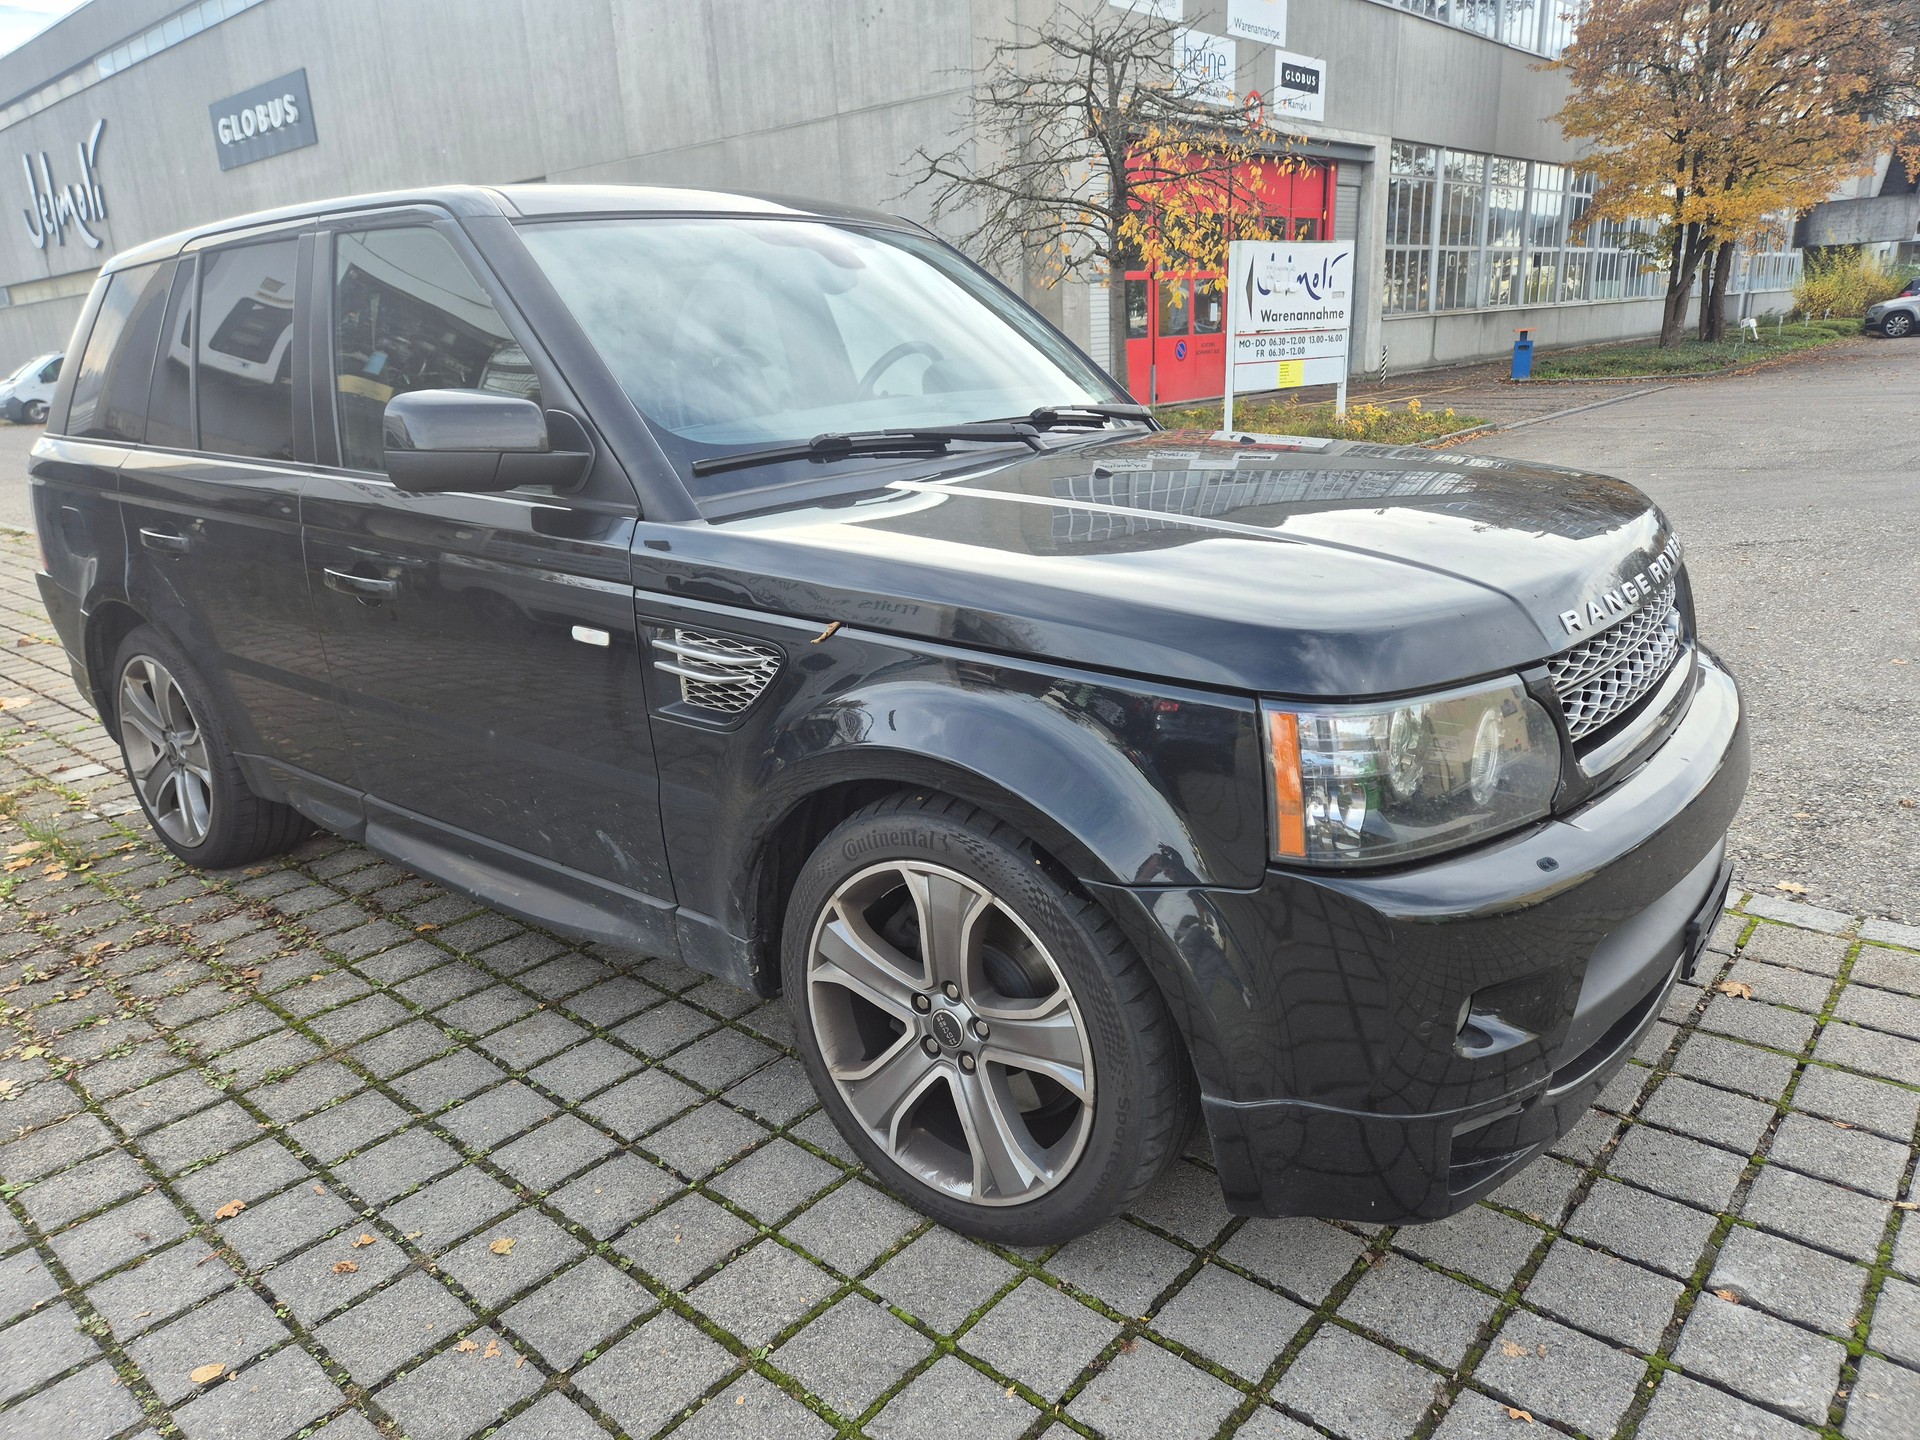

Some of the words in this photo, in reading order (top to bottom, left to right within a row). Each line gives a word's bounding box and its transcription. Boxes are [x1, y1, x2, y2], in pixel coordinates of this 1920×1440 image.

[1234, 17, 1280, 39] Warenannahme
[1183, 36, 1226, 80] heine
[1285, 70, 1316, 86] GLOBUS
[218, 94, 300, 145] GLOBUS
[23, 118, 106, 249] Jelmoli
[1260, 307, 1344, 323] Warenannahme
[1256, 350, 1265, 358] FR
[1559, 572, 1651, 635] RANGE
[1648, 532, 1682, 584] ROVER
[842, 829, 935, 861] Continental
